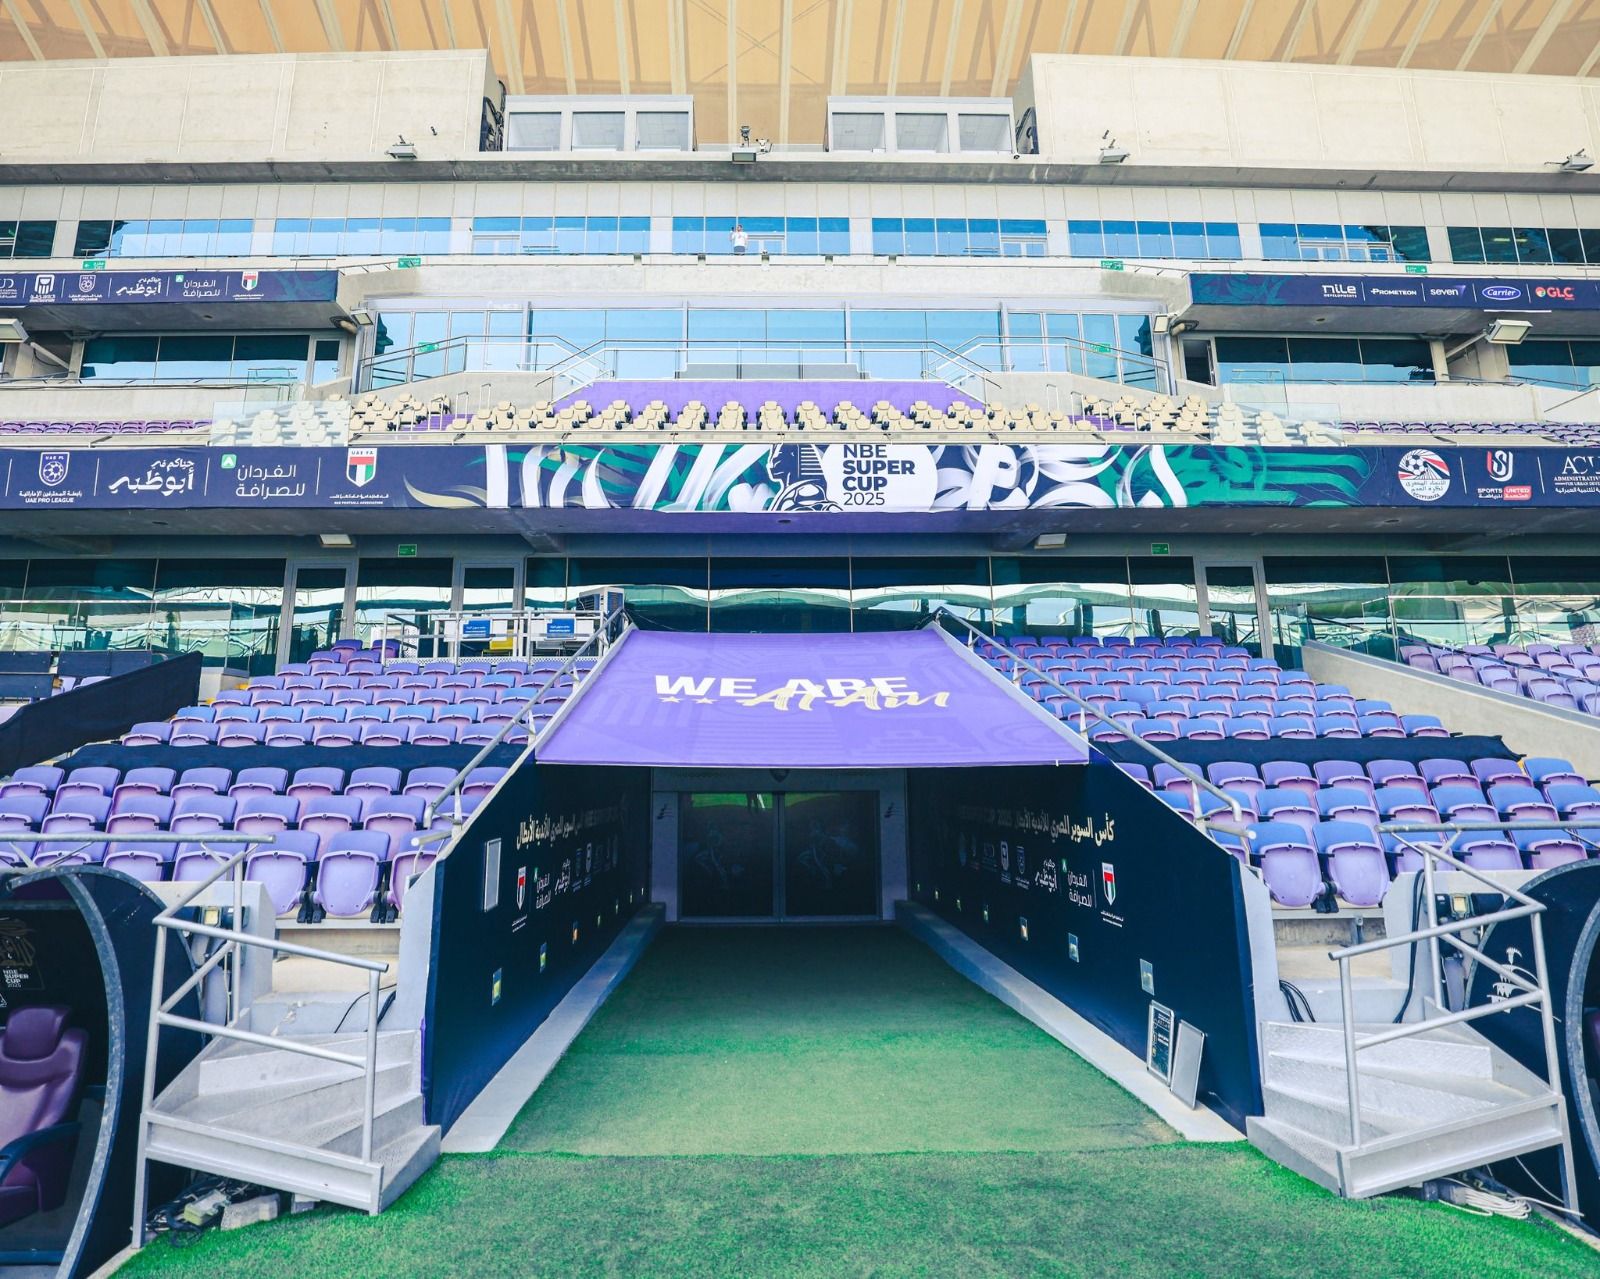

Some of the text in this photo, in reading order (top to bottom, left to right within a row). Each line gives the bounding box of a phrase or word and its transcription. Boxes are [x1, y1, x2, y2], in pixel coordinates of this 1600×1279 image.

[184, 279, 216, 288] الفردان
[182, 289, 220, 297] للصرافة
[1430, 288, 1458, 296] seven
[1487, 288, 1516, 296] Carrier
[1546, 287, 1574, 298] GLC
[843, 444, 888, 458] NBE
[167, 458, 194, 472] حياكم
[842, 460, 915, 475] SUPER
[237, 464, 296, 481] الفردان
[108, 467, 194, 496] أبوظبي
[842, 476, 888, 491] CUP
[235, 482, 305, 500] للصرافة
[844, 492, 885, 506] 2025
[655, 674, 918, 698] WE ARE
[1096, 812, 1115, 847] كأس
